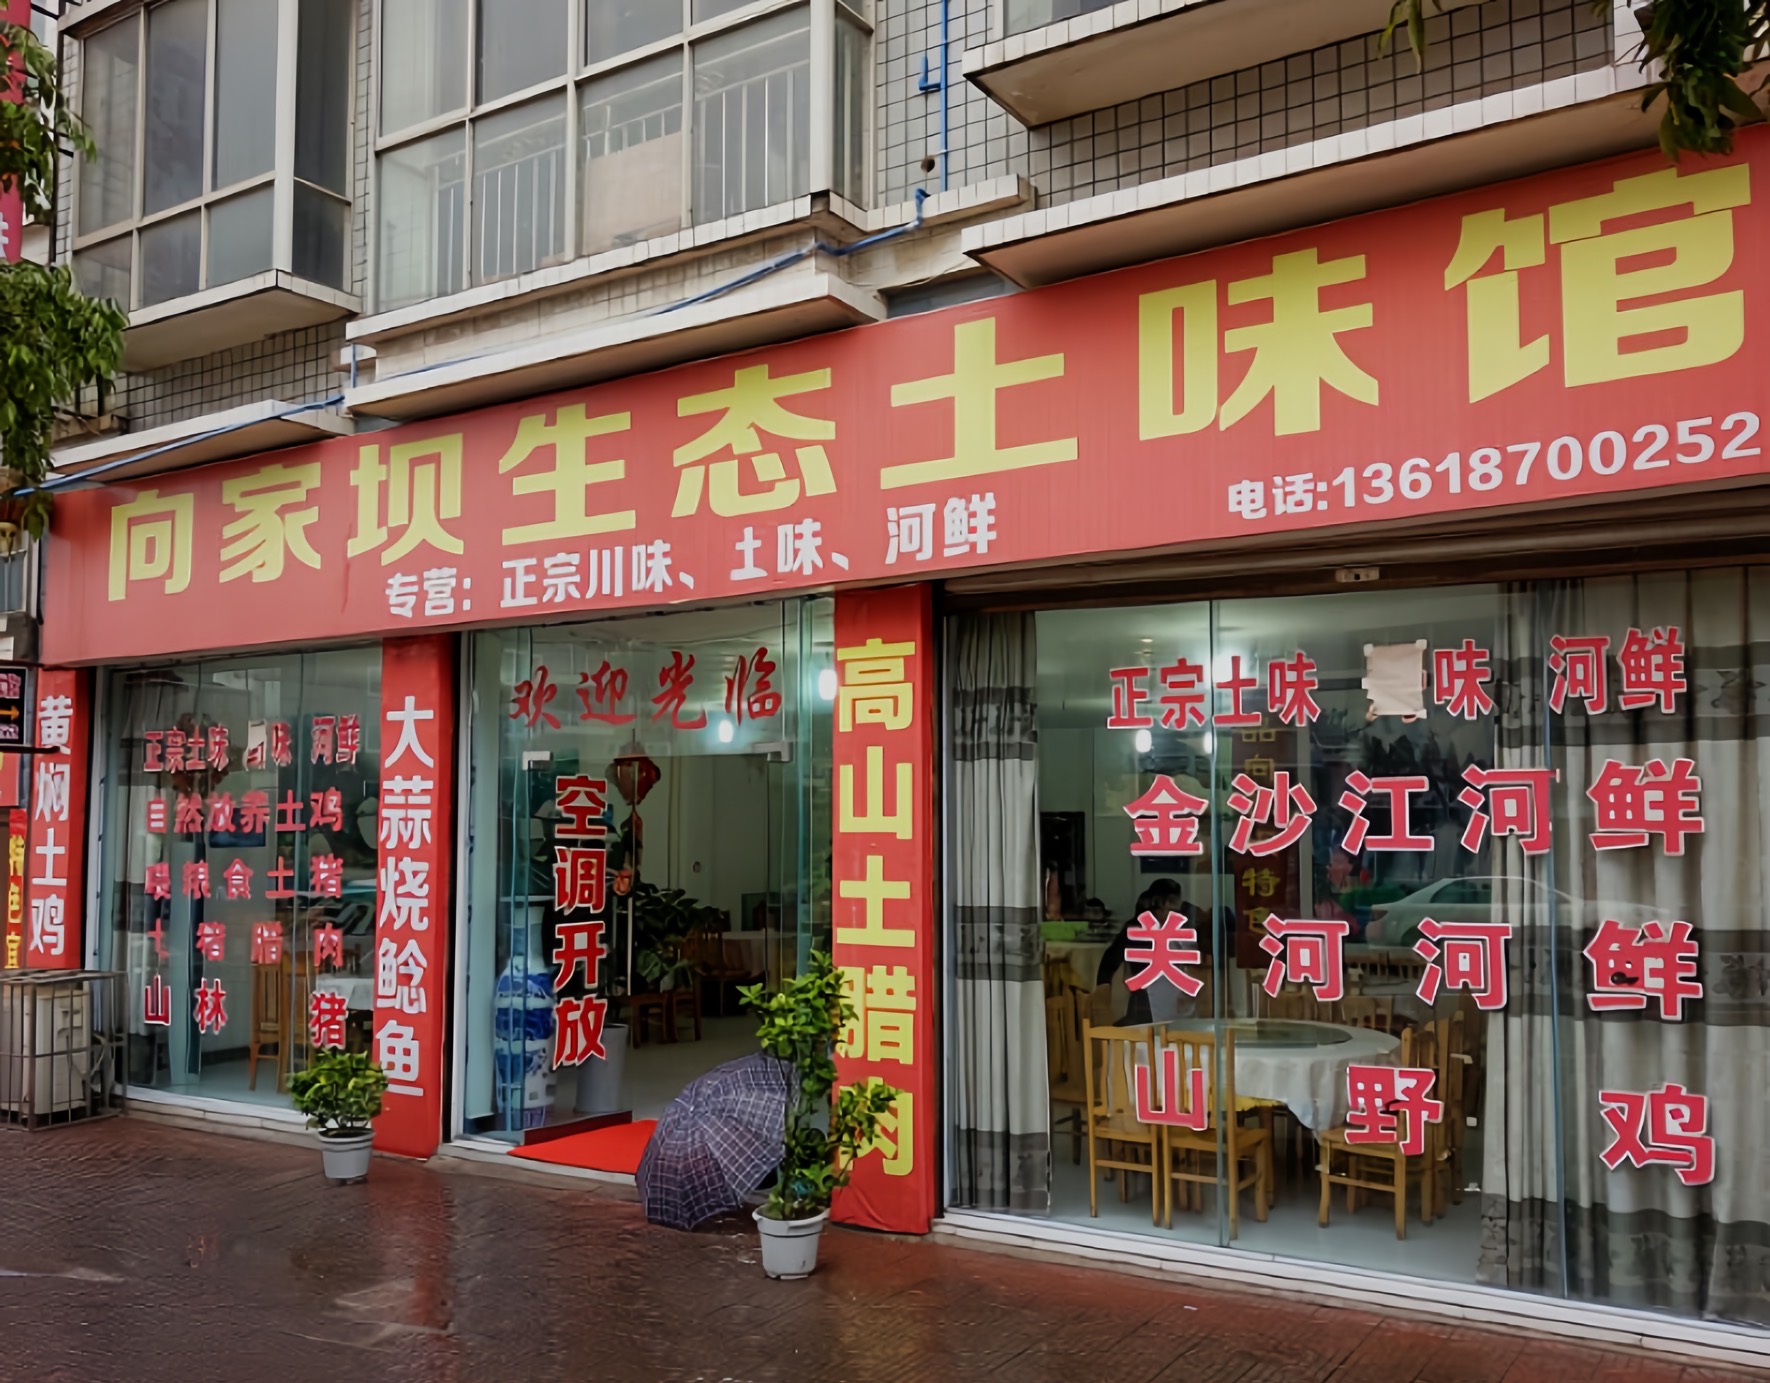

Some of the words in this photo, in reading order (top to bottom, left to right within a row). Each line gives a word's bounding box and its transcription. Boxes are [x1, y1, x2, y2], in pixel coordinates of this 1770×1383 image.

[108, 163, 1752, 601] 向家坝生态土味馆
[1228, 411, 1762, 521] 电话:13618700252
[510, 645, 784, 730] 欢迎光临
[1107, 651, 1321, 730] 正宗土味
[1548, 626, 1688, 715] 河鲜
[143, 725, 231, 773] 正宗土味
[28, 694, 73, 956] 黄焖土鸡
[146, 786, 344, 834] 自然放养土鸡
[1123, 758, 1704, 857] 金沙江河鲜
[552, 774, 608, 1070] 空调开放
[834, 636, 917, 1178] 高山土腊肉
[1124, 909, 1704, 1022] 关河河鲜
